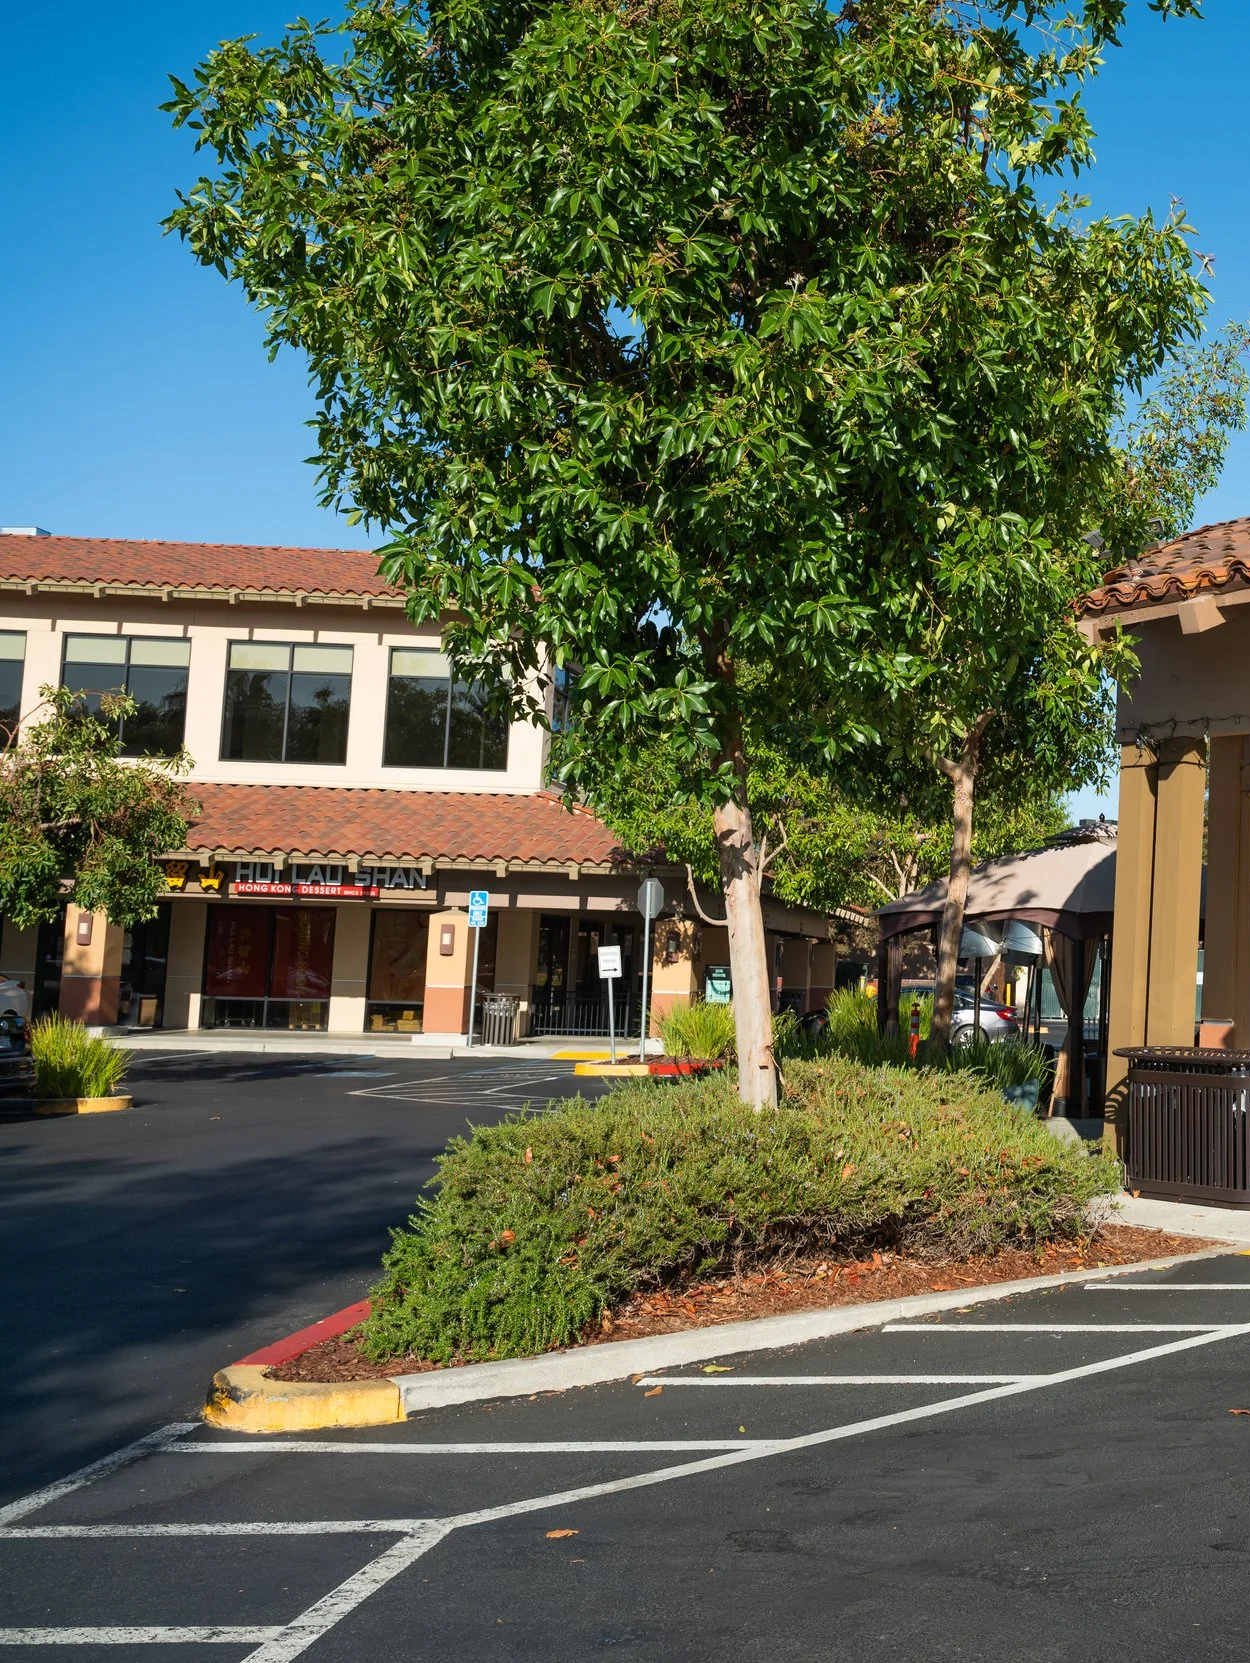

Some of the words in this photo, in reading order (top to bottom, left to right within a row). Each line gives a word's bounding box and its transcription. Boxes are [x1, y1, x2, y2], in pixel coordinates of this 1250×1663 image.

[236, 862, 280, 884] HUI
[291, 864, 342, 885] LAU
[355, 866, 426, 888] SHAN
[238, 884, 269, 892] HONG
[271, 885, 299, 893] KONG
[301, 885, 342, 895] DESSERT
